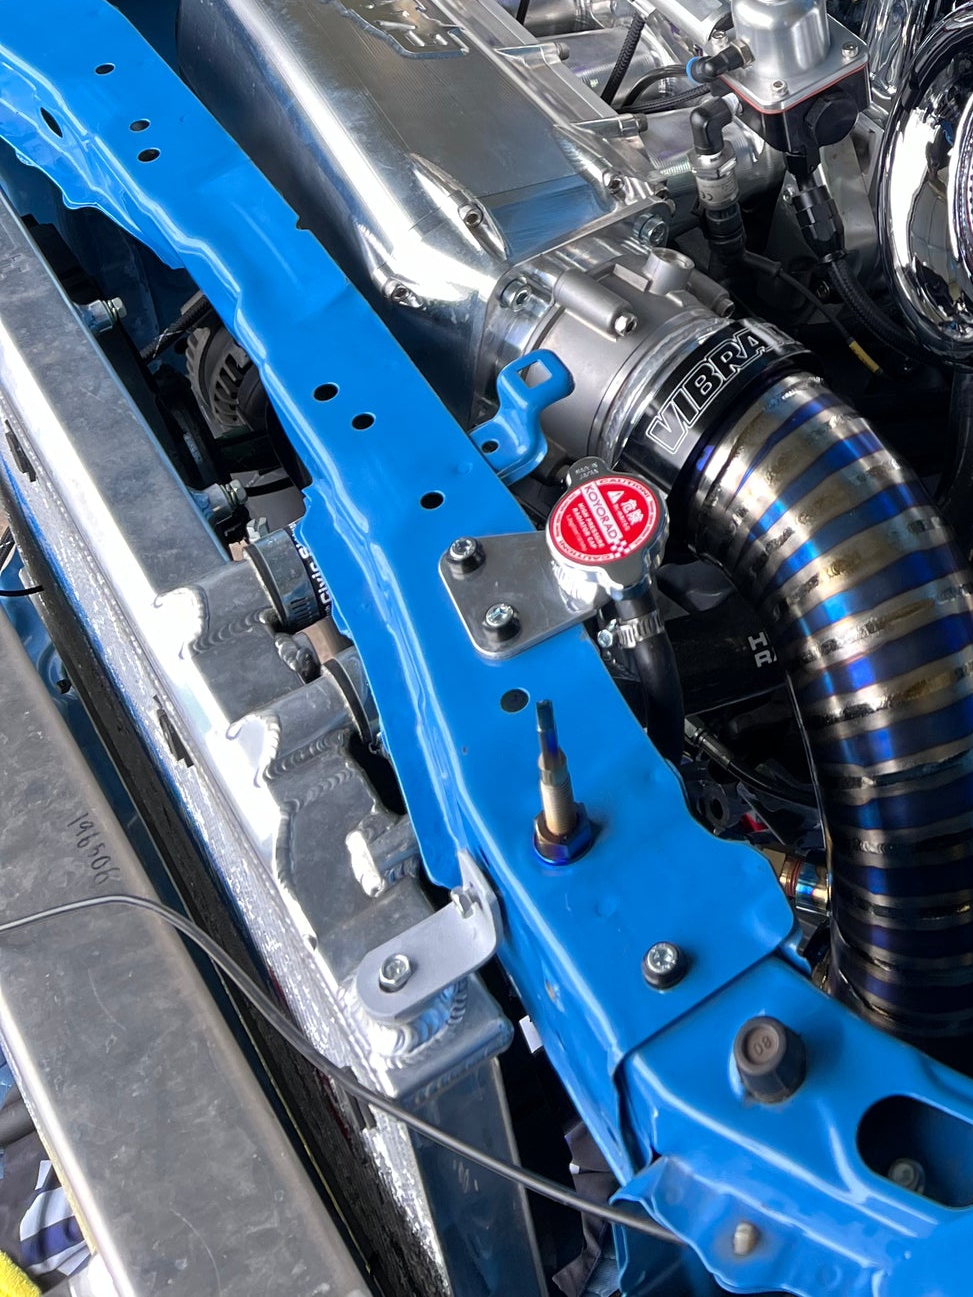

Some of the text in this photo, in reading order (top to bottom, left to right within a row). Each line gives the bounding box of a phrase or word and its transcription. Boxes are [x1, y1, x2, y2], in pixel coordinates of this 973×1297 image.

[571, 507, 591, 539] RADIATOR
[587, 538, 599, 550] CAP
[584, 485, 618, 540] KOYORAD
[585, 517, 606, 549] PRESSURE
